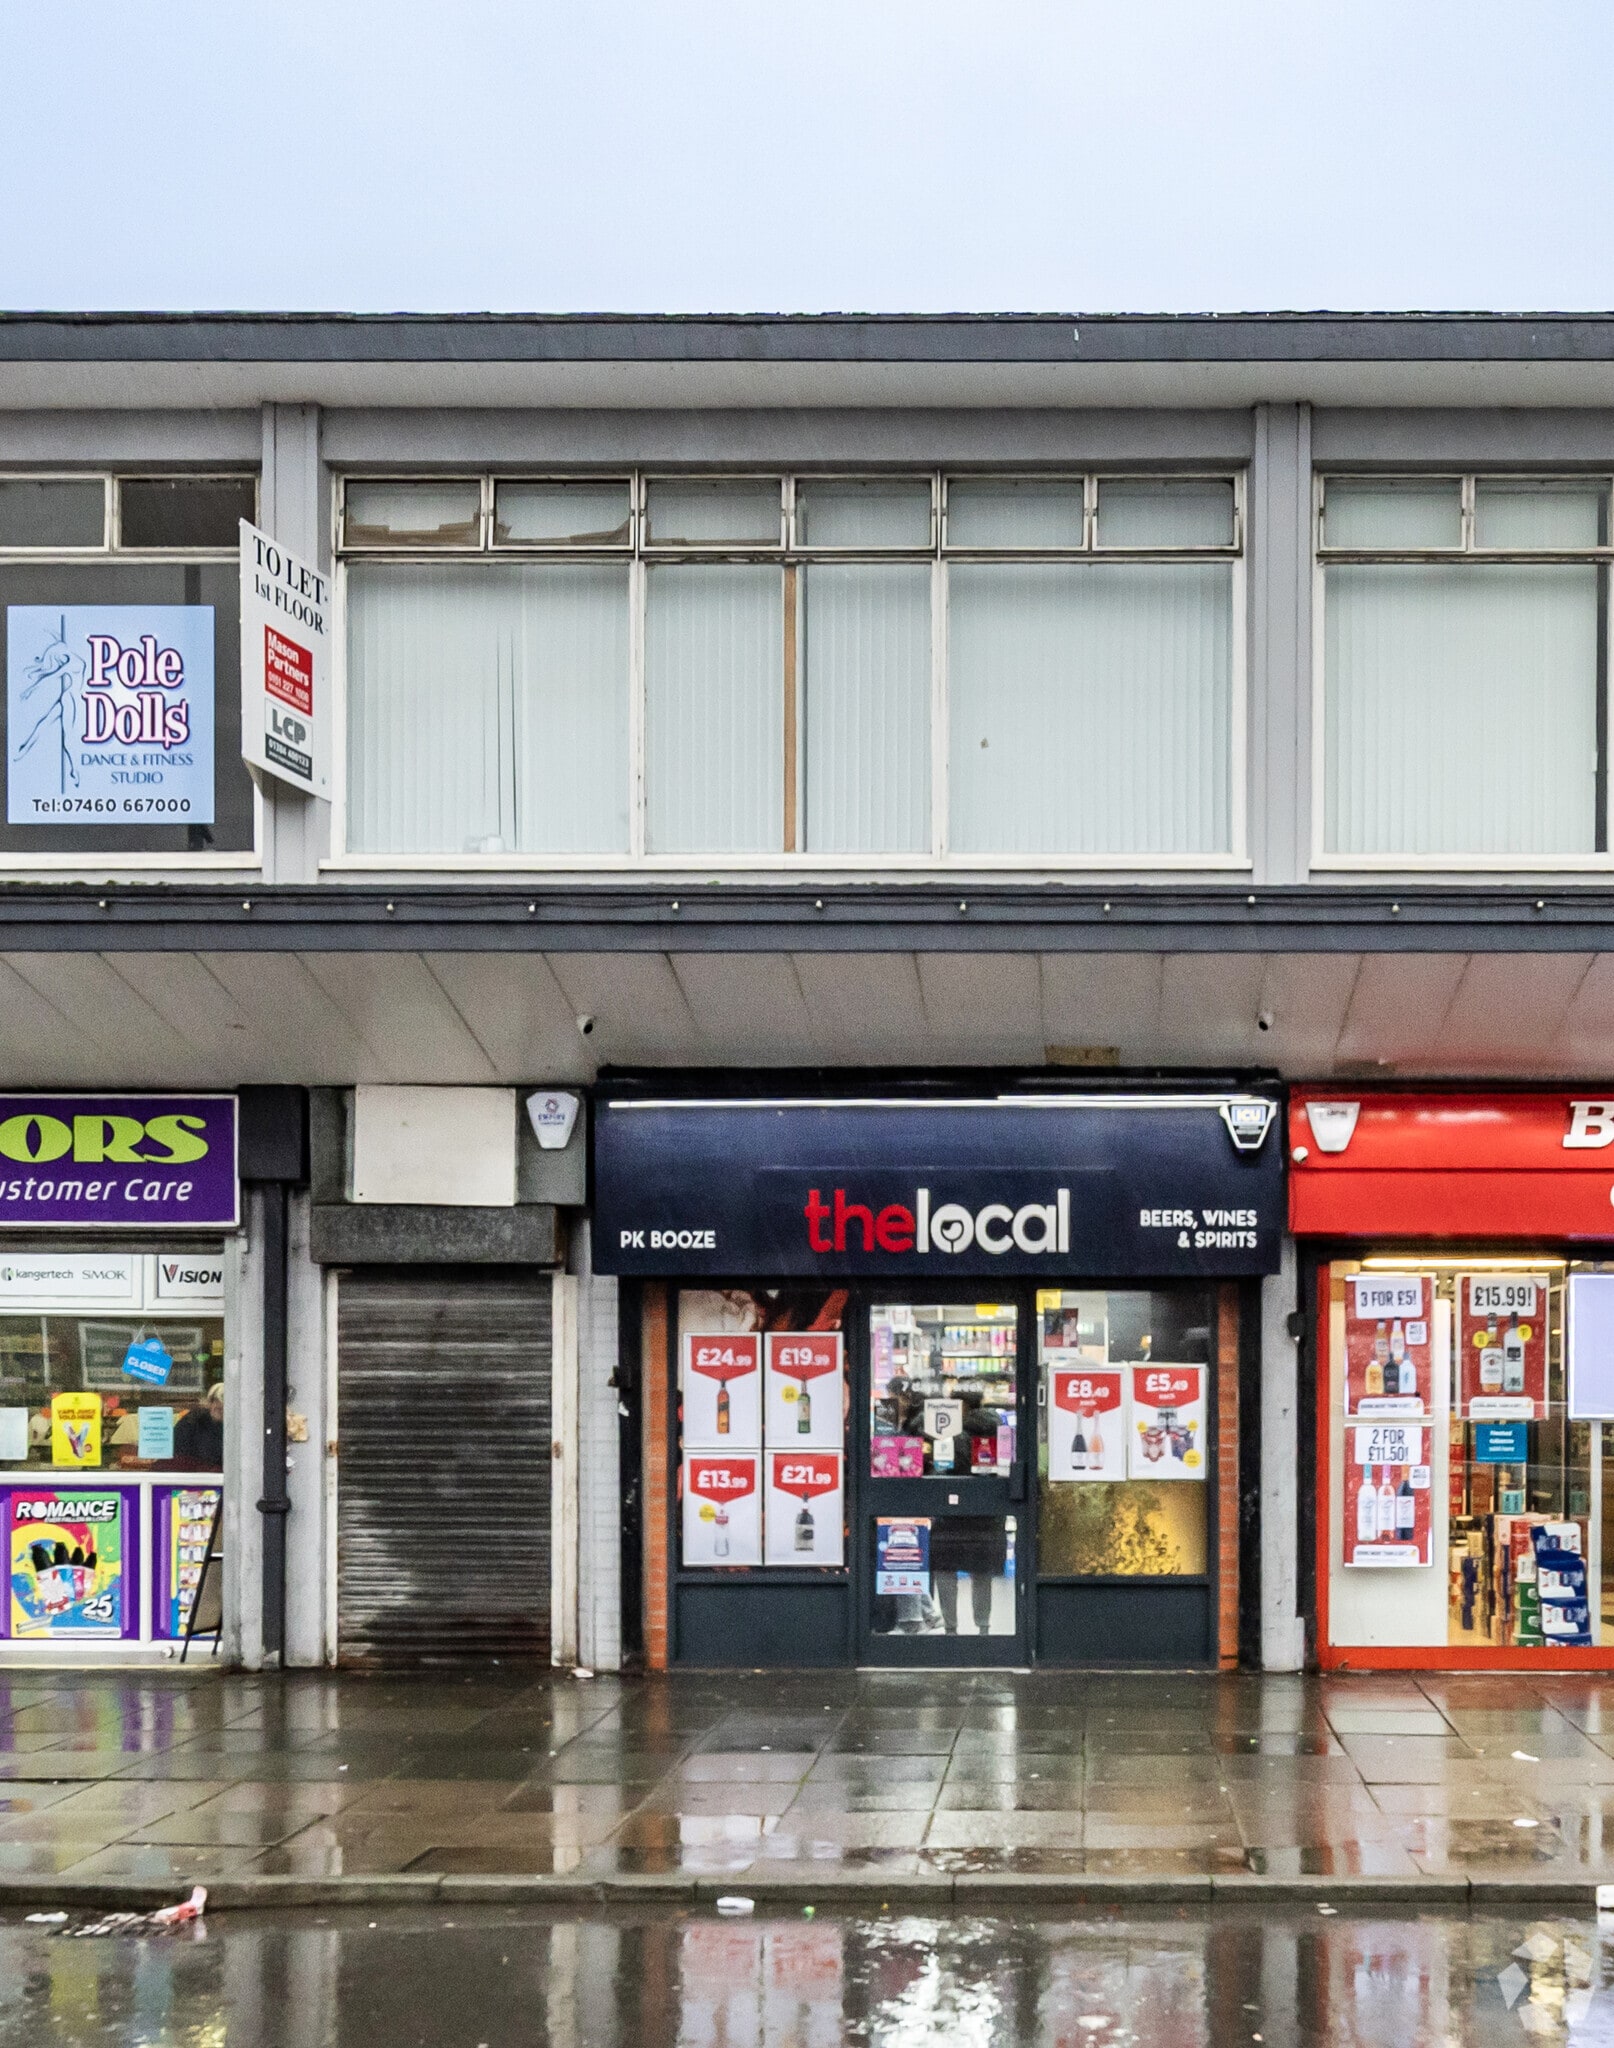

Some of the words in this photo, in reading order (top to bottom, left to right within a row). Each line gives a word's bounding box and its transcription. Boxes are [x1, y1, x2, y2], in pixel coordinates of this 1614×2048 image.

[253, 535, 281, 576] TO
[286, 557, 324, 605] LET
[255, 574, 270, 601] 1st
[275, 586, 323, 634] FLOOR
[268, 631, 299, 664] Mason
[87, 635, 184, 689] Pole
[268, 648, 309, 686] Partners
[81, 692, 190, 749] Dolls
[272, 708, 306, 744] LCP
[81, 753, 127, 766] DANCE
[130, 753, 139, 766] &
[142, 753, 193, 766] FITNESS
[110, 771, 163, 784] STUDIO
[32, 798, 117, 812] Tel:07460
[124, 799, 191, 812] 667000
[0, 1114, 208, 1163] ORS
[124, 1179, 193, 1201] Care
[1139, 1209, 1198, 1229] BEERS,
[1202, 1209, 1257, 1226] WINES
[620, 1231, 645, 1249] PK
[650, 1230, 716, 1249] BOOZE
[1177, 1231, 1190, 1248] &
[1194, 1231, 1257, 1248] SPIRITS
[16, 1268, 74, 1281] kangertech
[162, 1264, 222, 1284] VISION
[1360, 1292, 1368, 1307] 3
[1371, 1291, 1393, 1306] FOR
[1397, 1290, 1417, 1306] £5!
[1474, 1286, 1532, 1307] £15.99!
[696, 1347, 752, 1367] £24.99
[779, 1347, 830, 1367] £19.99
[1066, 1379, 1110, 1399] £8.49
[1145, 1373, 1189, 1392] £5.49
[1372, 1429, 1380, 1444] 2
[1382, 1429, 1405, 1444] FOR
[1368, 1446, 1409, 1462] £11.50!
[697, 1469, 748, 1489] £13.99
[781, 1465, 832, 1485] £21.99
[16, 1500, 116, 1519] ROMANCE
[82, 1594, 113, 1618] 25
